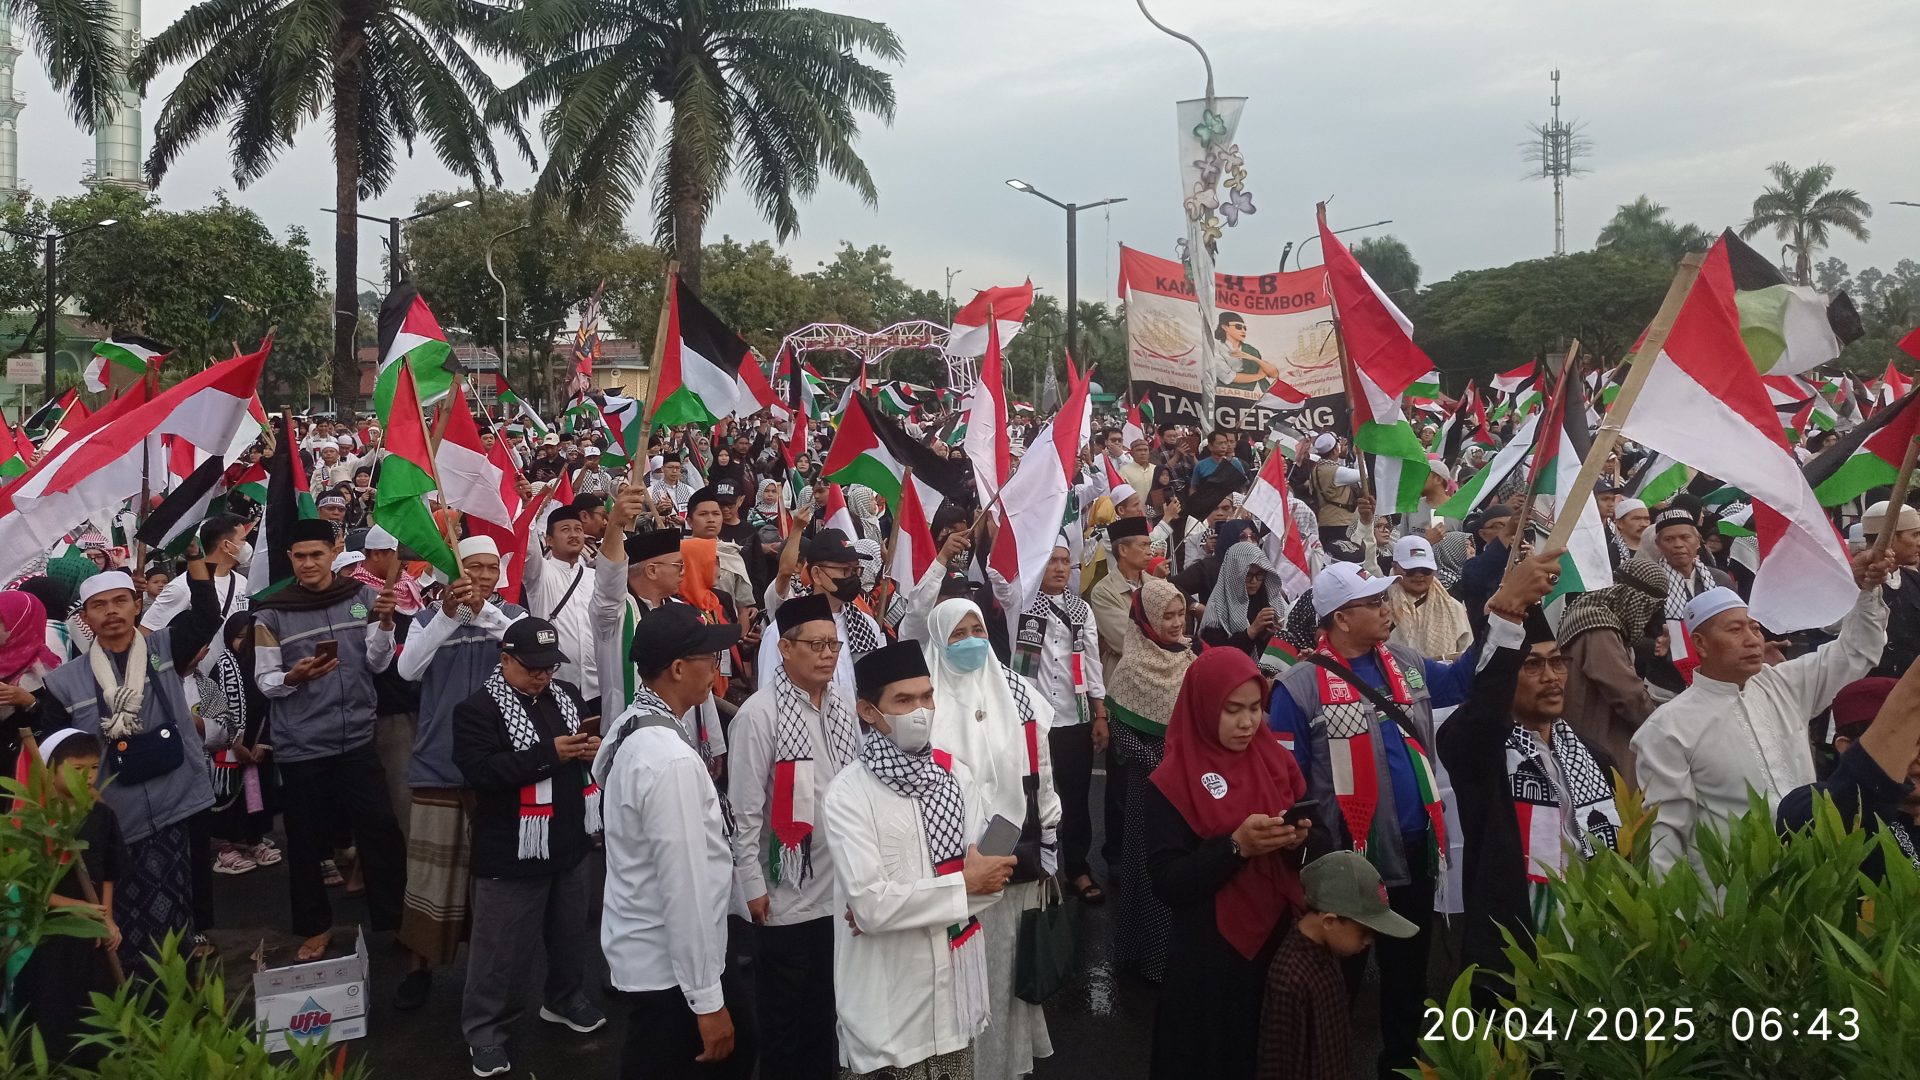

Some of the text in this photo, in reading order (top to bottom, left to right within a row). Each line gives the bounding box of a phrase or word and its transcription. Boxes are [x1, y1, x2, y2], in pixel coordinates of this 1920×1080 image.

[1156, 276, 1316, 310] KAMNG GEMBOR
[1158, 392, 1335, 431] TAGERNG
